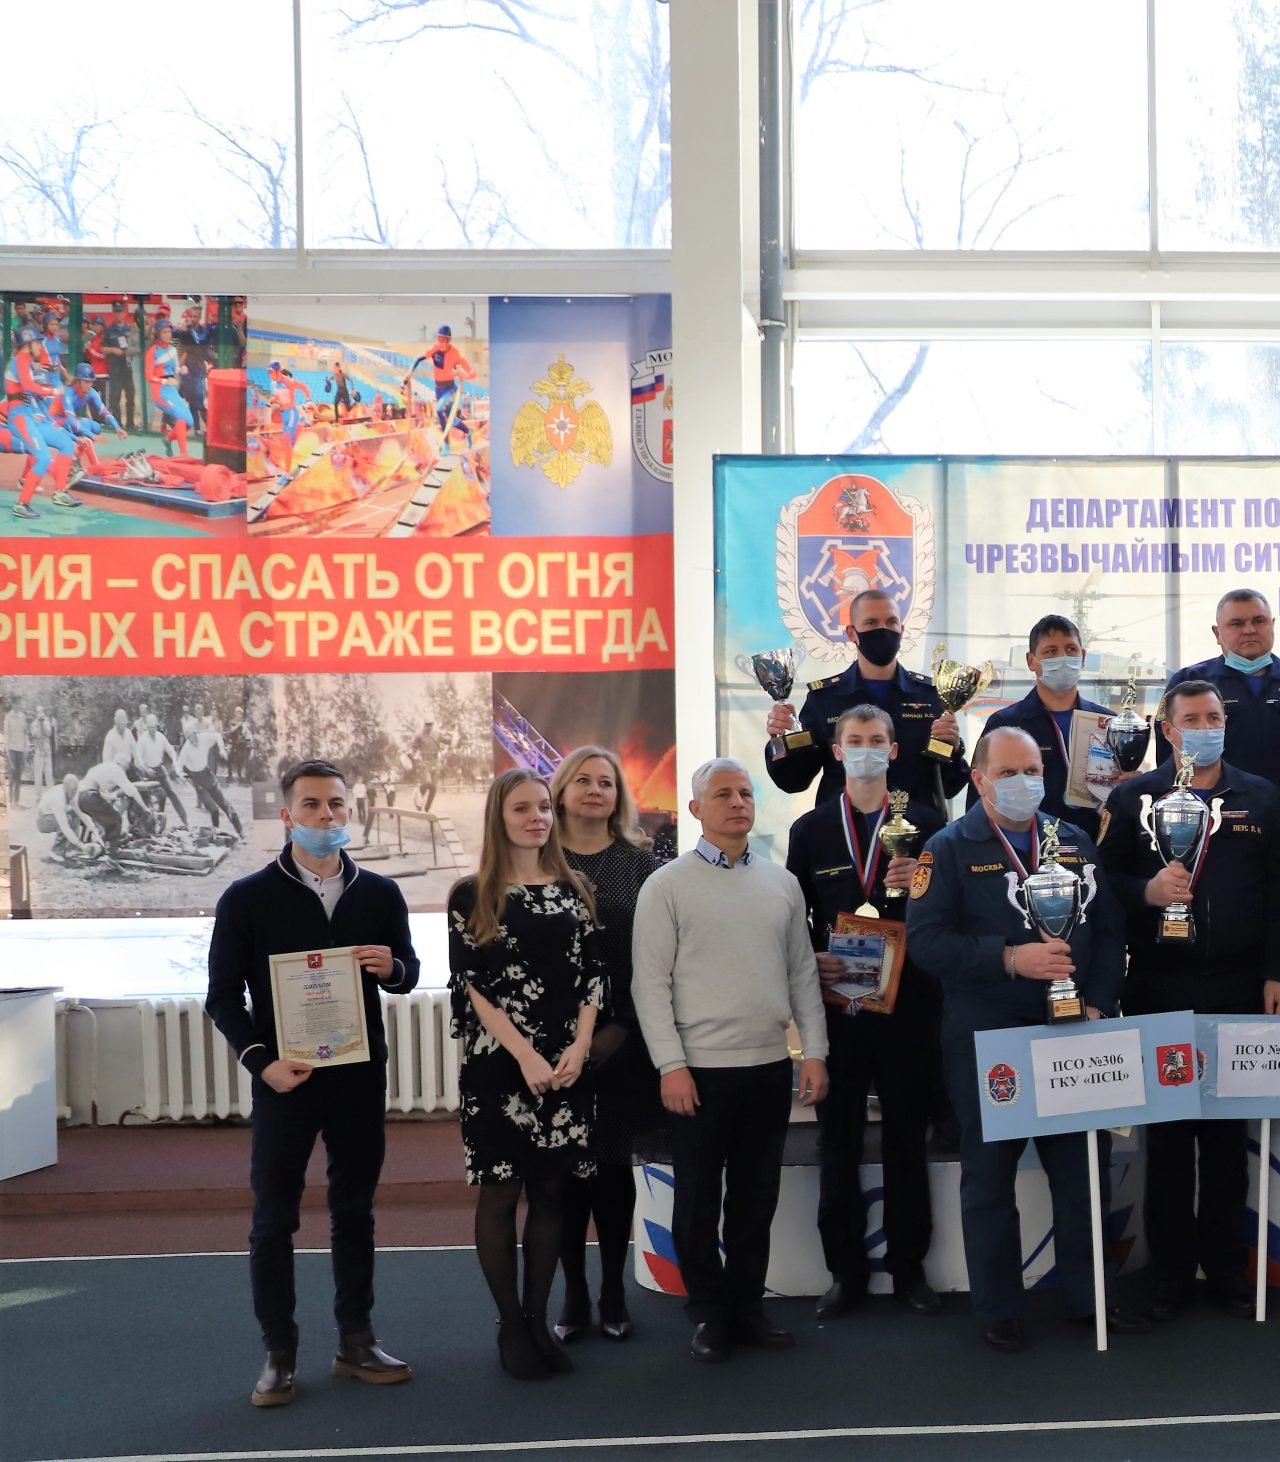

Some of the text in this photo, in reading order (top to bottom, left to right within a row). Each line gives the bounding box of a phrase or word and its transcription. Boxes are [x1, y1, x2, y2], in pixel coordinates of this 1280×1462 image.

[1026, 498, 1236, 533] ДЕПАРТАМЕНТ
[965, 537, 1226, 574] ЧРЕЗВЫЧАЙНЫМ
[151, 552, 400, 601] СПАСАТЬ
[415, 552, 484, 599] ОТ
[498, 551, 634, 599] ОГНЯ
[153, 611, 226, 658] НА
[240, 610, 454, 659] СТРАЖЕ
[470, 607, 669, 664] ВСЕГДА
[971, 863, 1004, 873] МОСКВА
[1236, 1044, 1264, 1055] ПСО
[1053, 1053, 1124, 1072] ПСО №306
[1231, 1060, 1258, 1071] ГКУ
[1050, 1070, 1130, 1089] ГКУ «ПСЦ»
